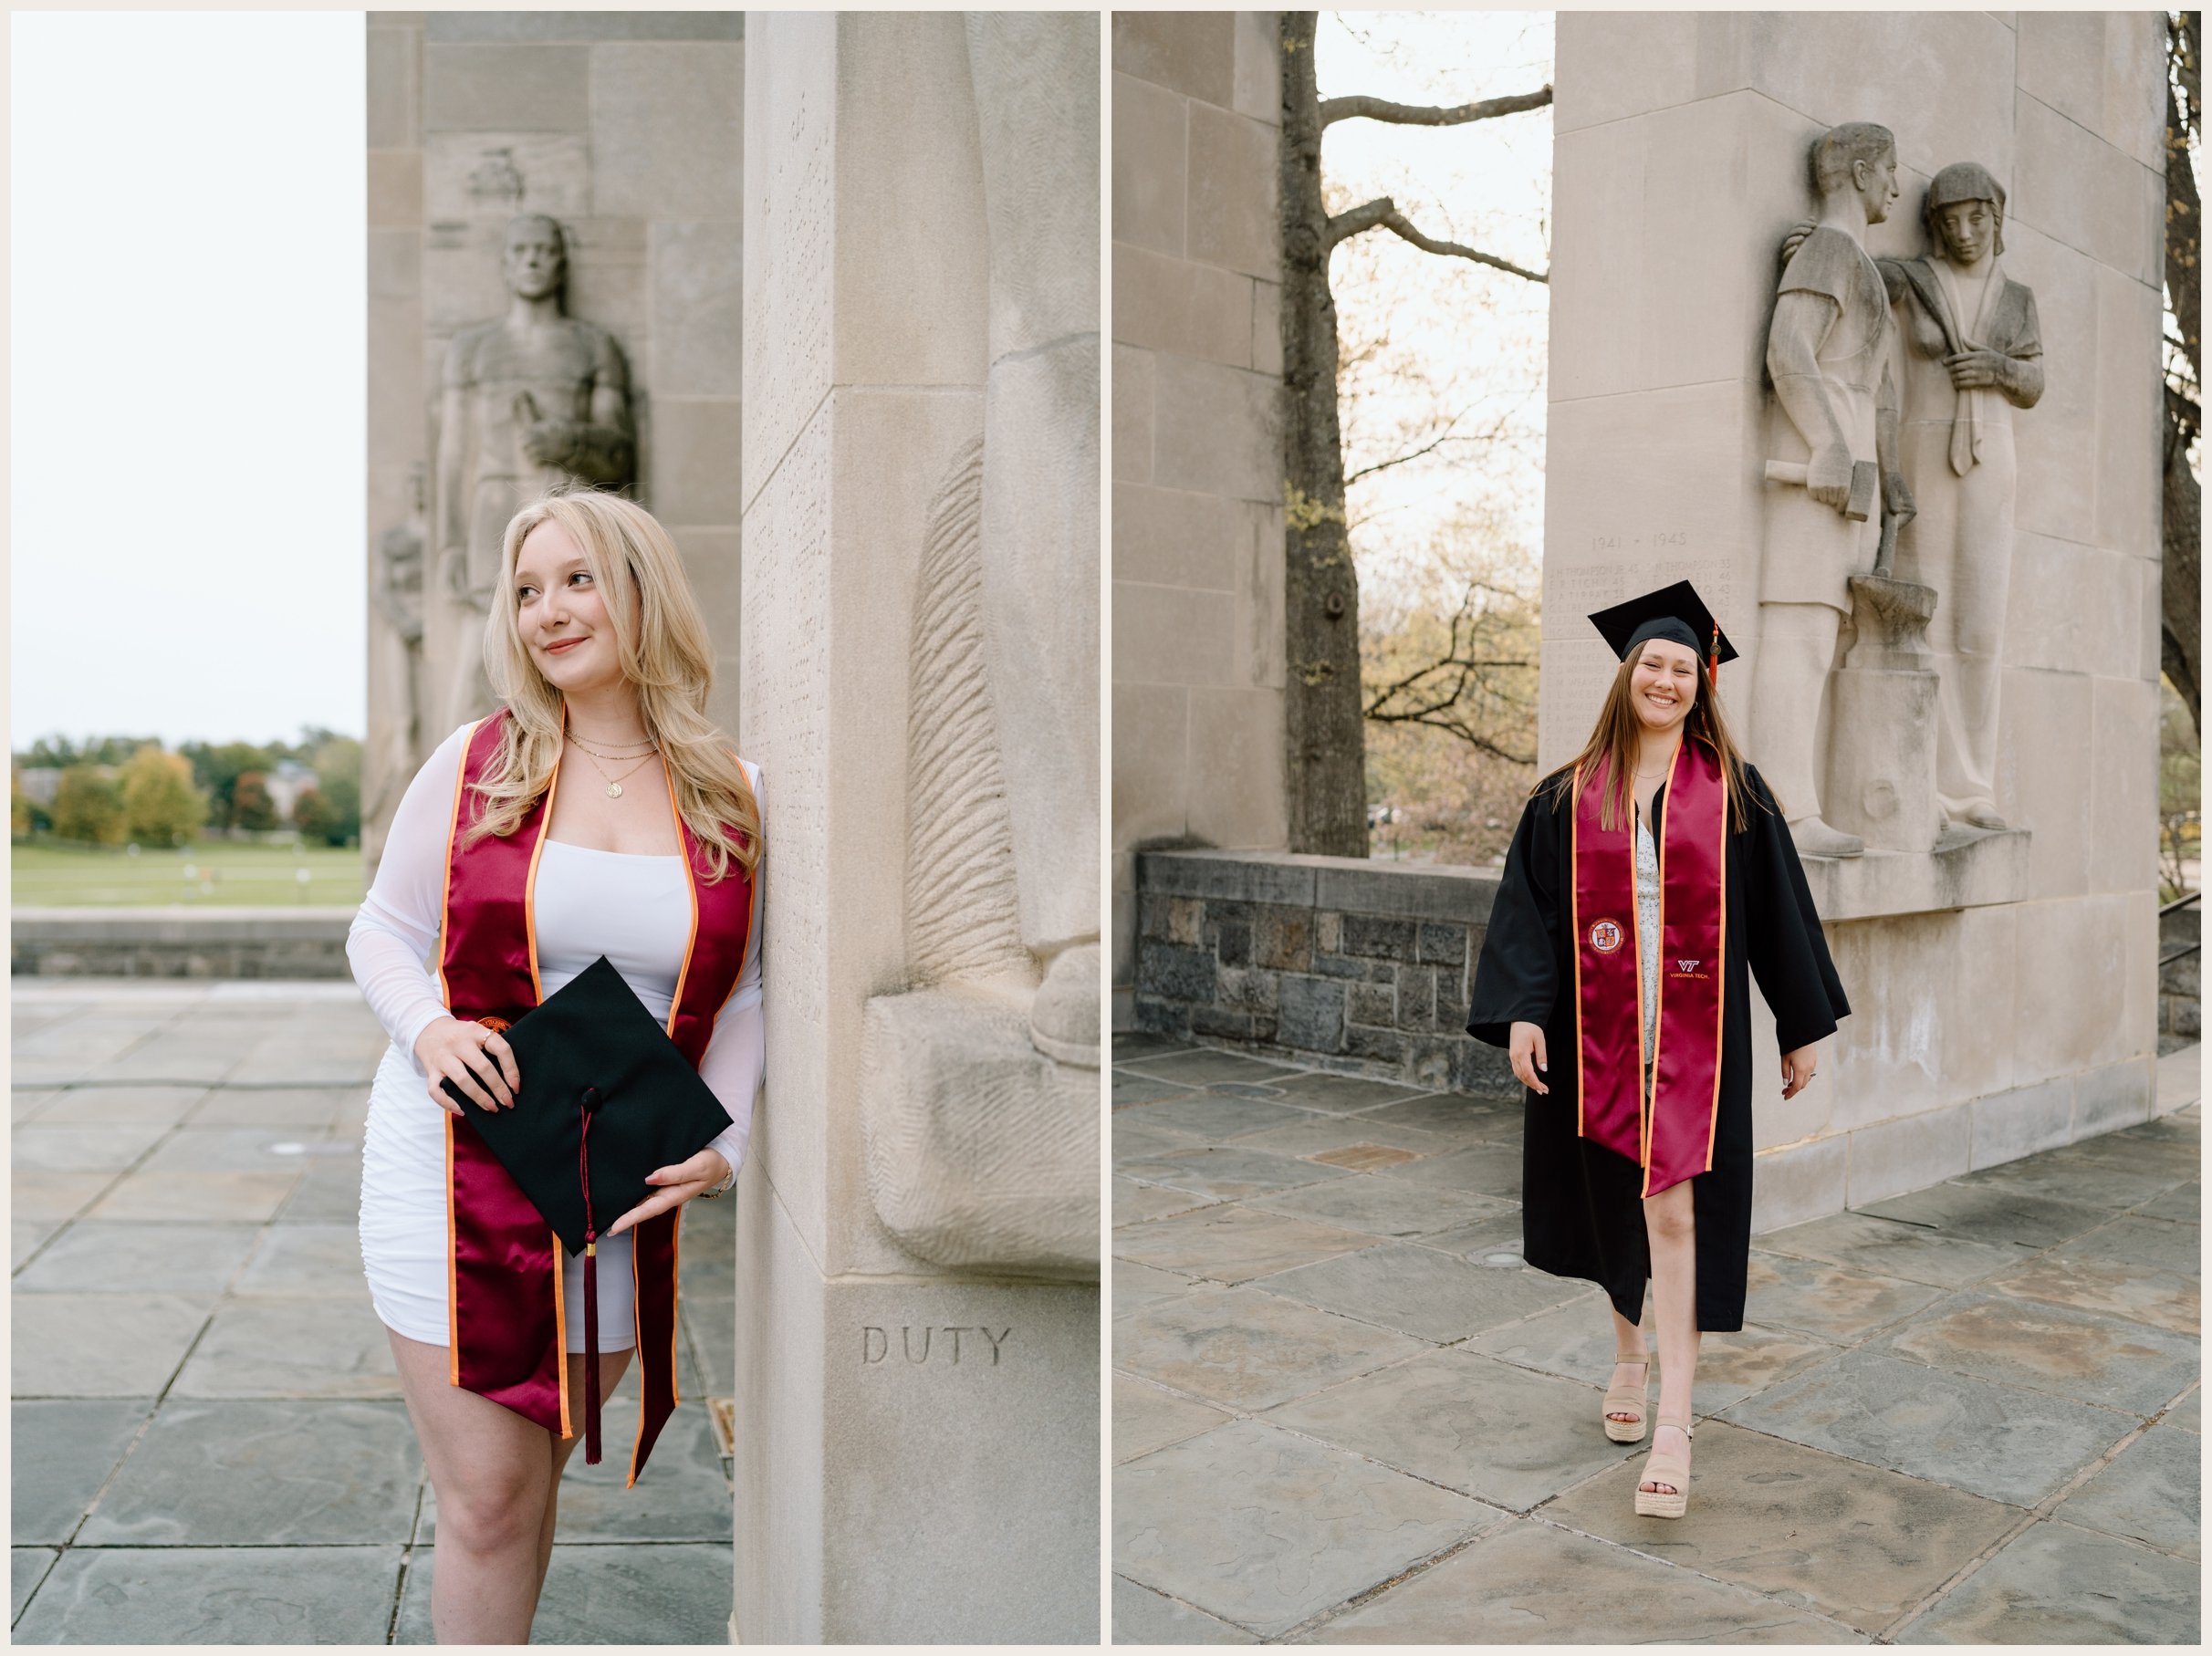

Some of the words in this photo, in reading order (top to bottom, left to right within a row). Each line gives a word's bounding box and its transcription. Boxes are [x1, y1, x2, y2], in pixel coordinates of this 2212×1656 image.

[1591, 536, 1622, 551] 1941
[1653, 532, 1687, 547] 1945
[1565, 565, 1612, 578] THOMPSON
[1665, 560, 1717, 573] THOMPSON
[1570, 577, 1608, 589] TICHY
[1677, 960, 1700, 972] VT
[862, 1327, 1011, 1367] DUTY
